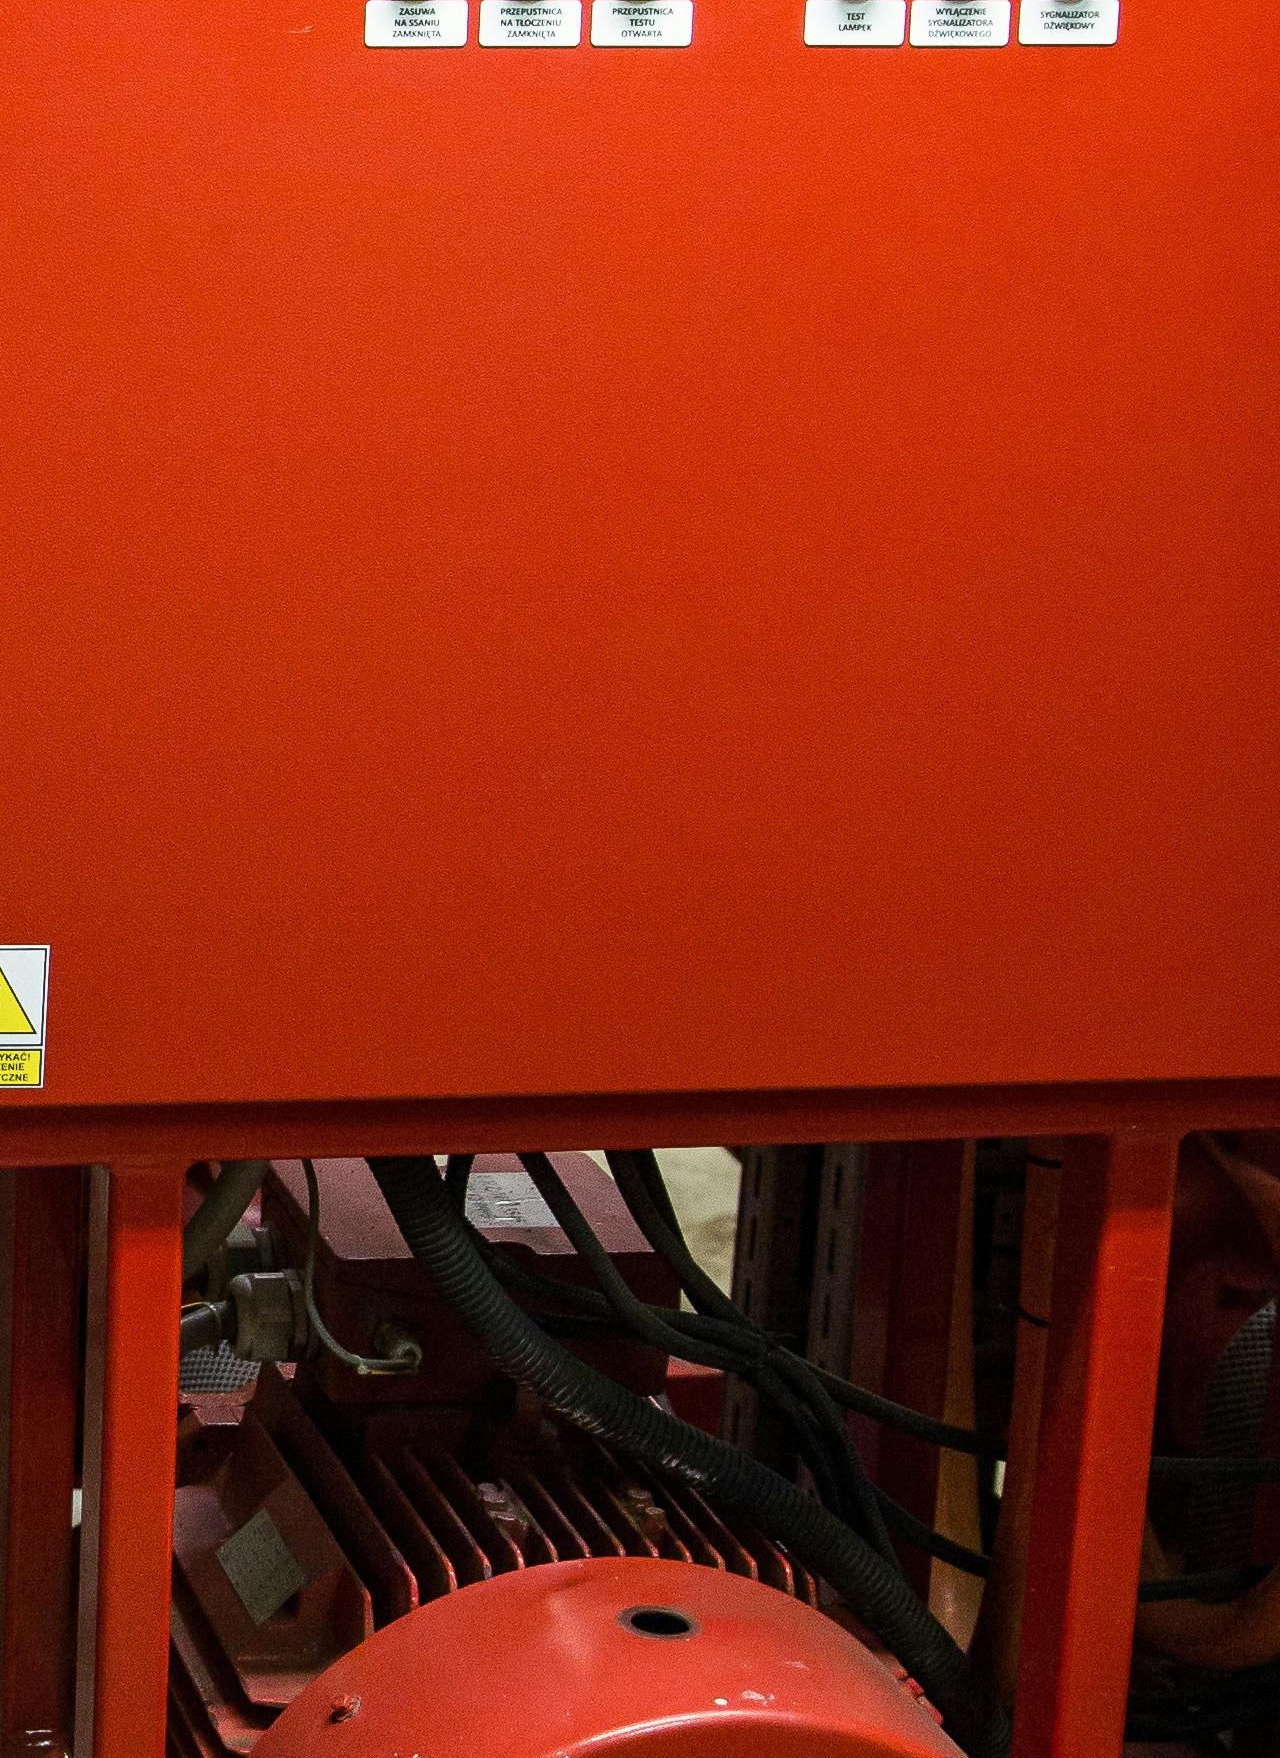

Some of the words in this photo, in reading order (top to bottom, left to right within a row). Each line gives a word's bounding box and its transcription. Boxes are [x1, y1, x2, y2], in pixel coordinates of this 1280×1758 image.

[398, 8, 436, 16] ZASUWA
[500, 8, 563, 16] PRZEPUSTNICA
[612, 8, 674, 16] PRZEPUSTNICA
[935, 8, 987, 18] WYŁĄCZENIE
[1039, 11, 1101, 20] SYGNALIZATOR
[846, 13, 865, 21] TEST
[394, 18, 408, 27] NA
[408, 18, 441, 27] SSANIU
[500, 18, 514, 27] NA
[515, 18, 562, 27] TŁOCZENIU
[629, 19, 656, 27] TESTU
[927, 19, 994, 27] SYGNALIZATORA
[838, 23, 872, 32] LAMPEK
[392, 30, 442, 39] ZAMKNIĘTA
[507, 30, 557, 39] ZAMKNIĘTA
[621, 30, 663, 38] OTWARTA
